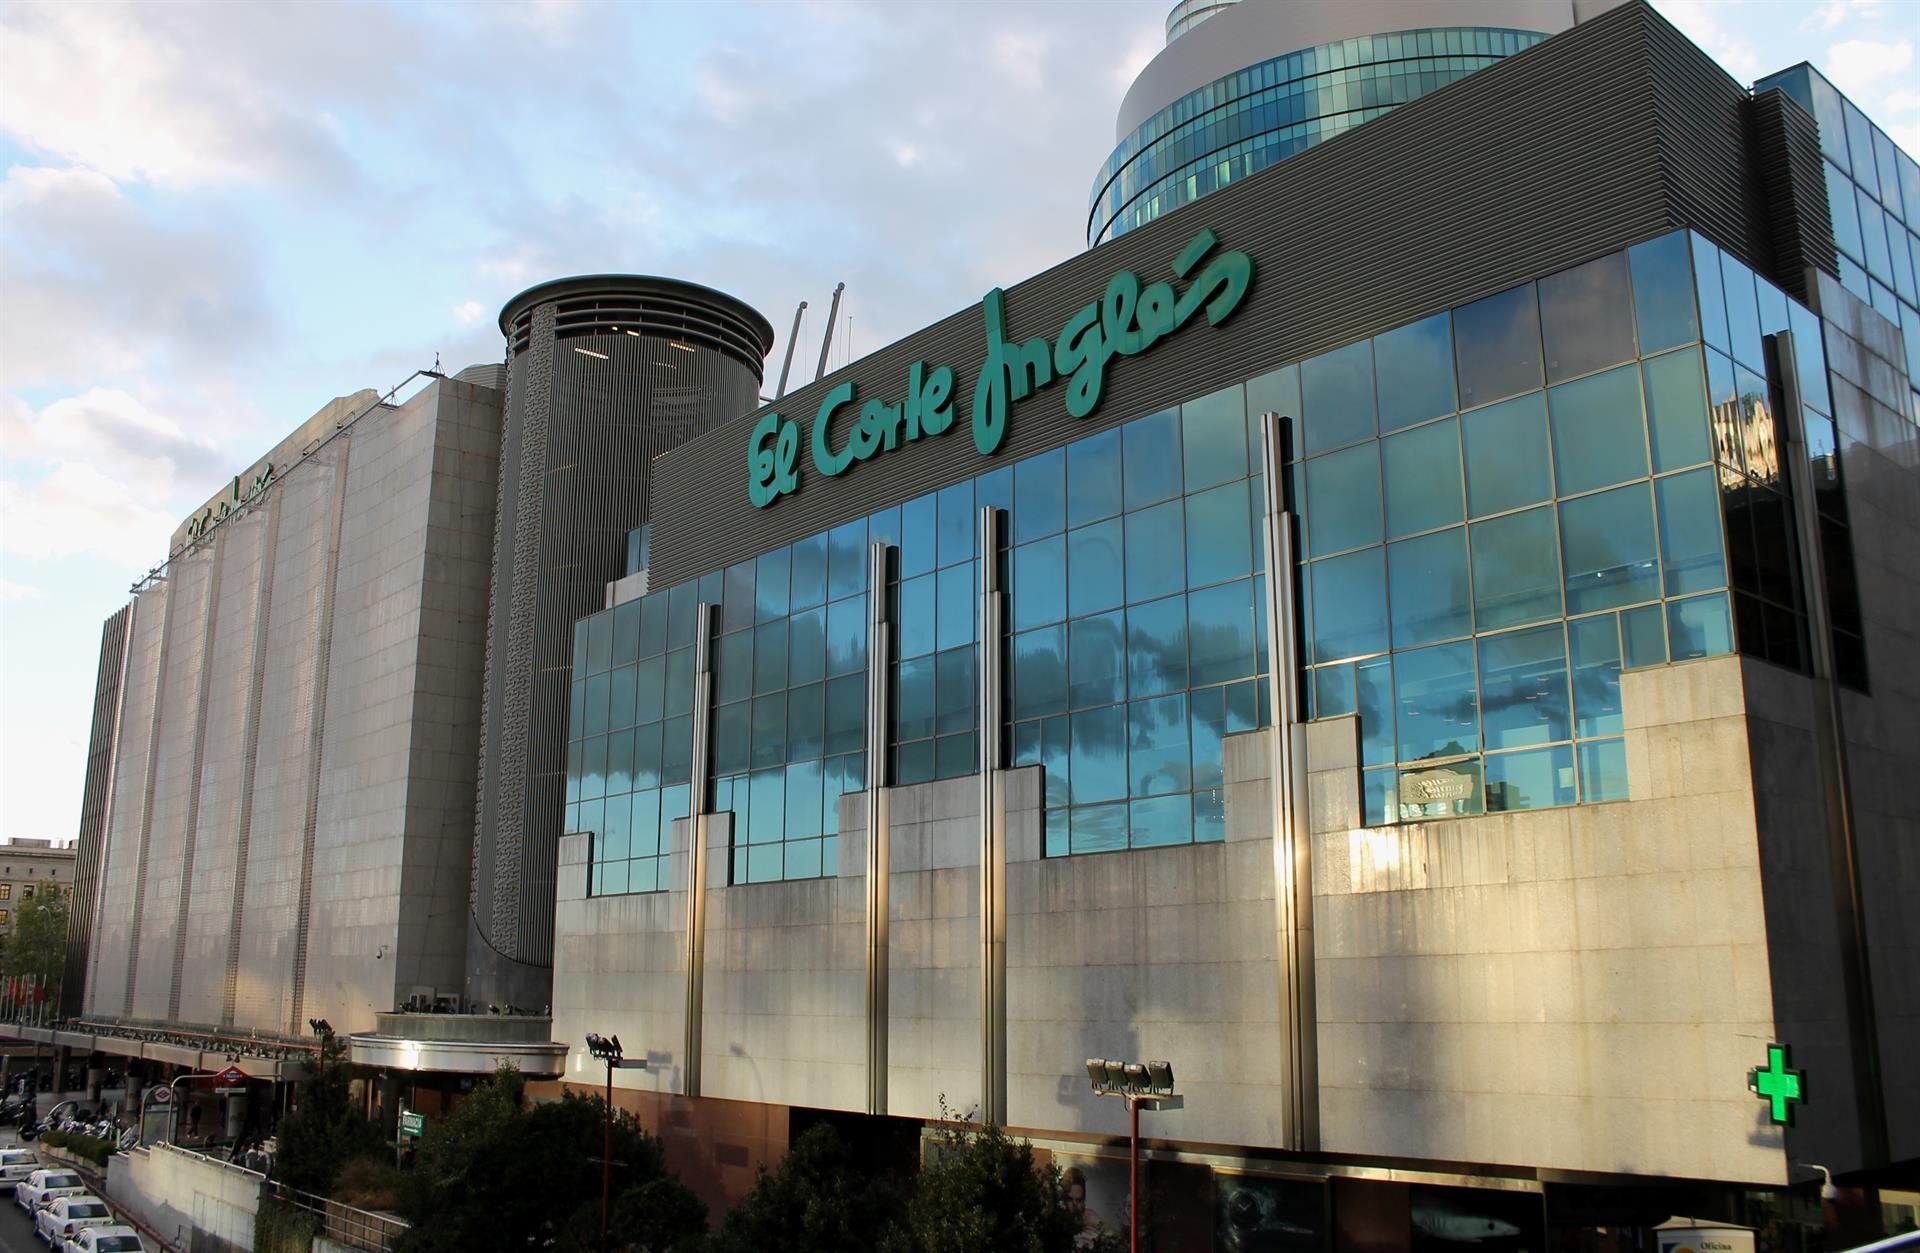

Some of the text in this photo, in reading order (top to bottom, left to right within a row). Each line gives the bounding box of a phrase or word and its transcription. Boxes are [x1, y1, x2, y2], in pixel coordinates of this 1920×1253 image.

[748, 227, 1257, 508] El Corte Inglés
[1700, 1240, 1732, 1250] Oficina
